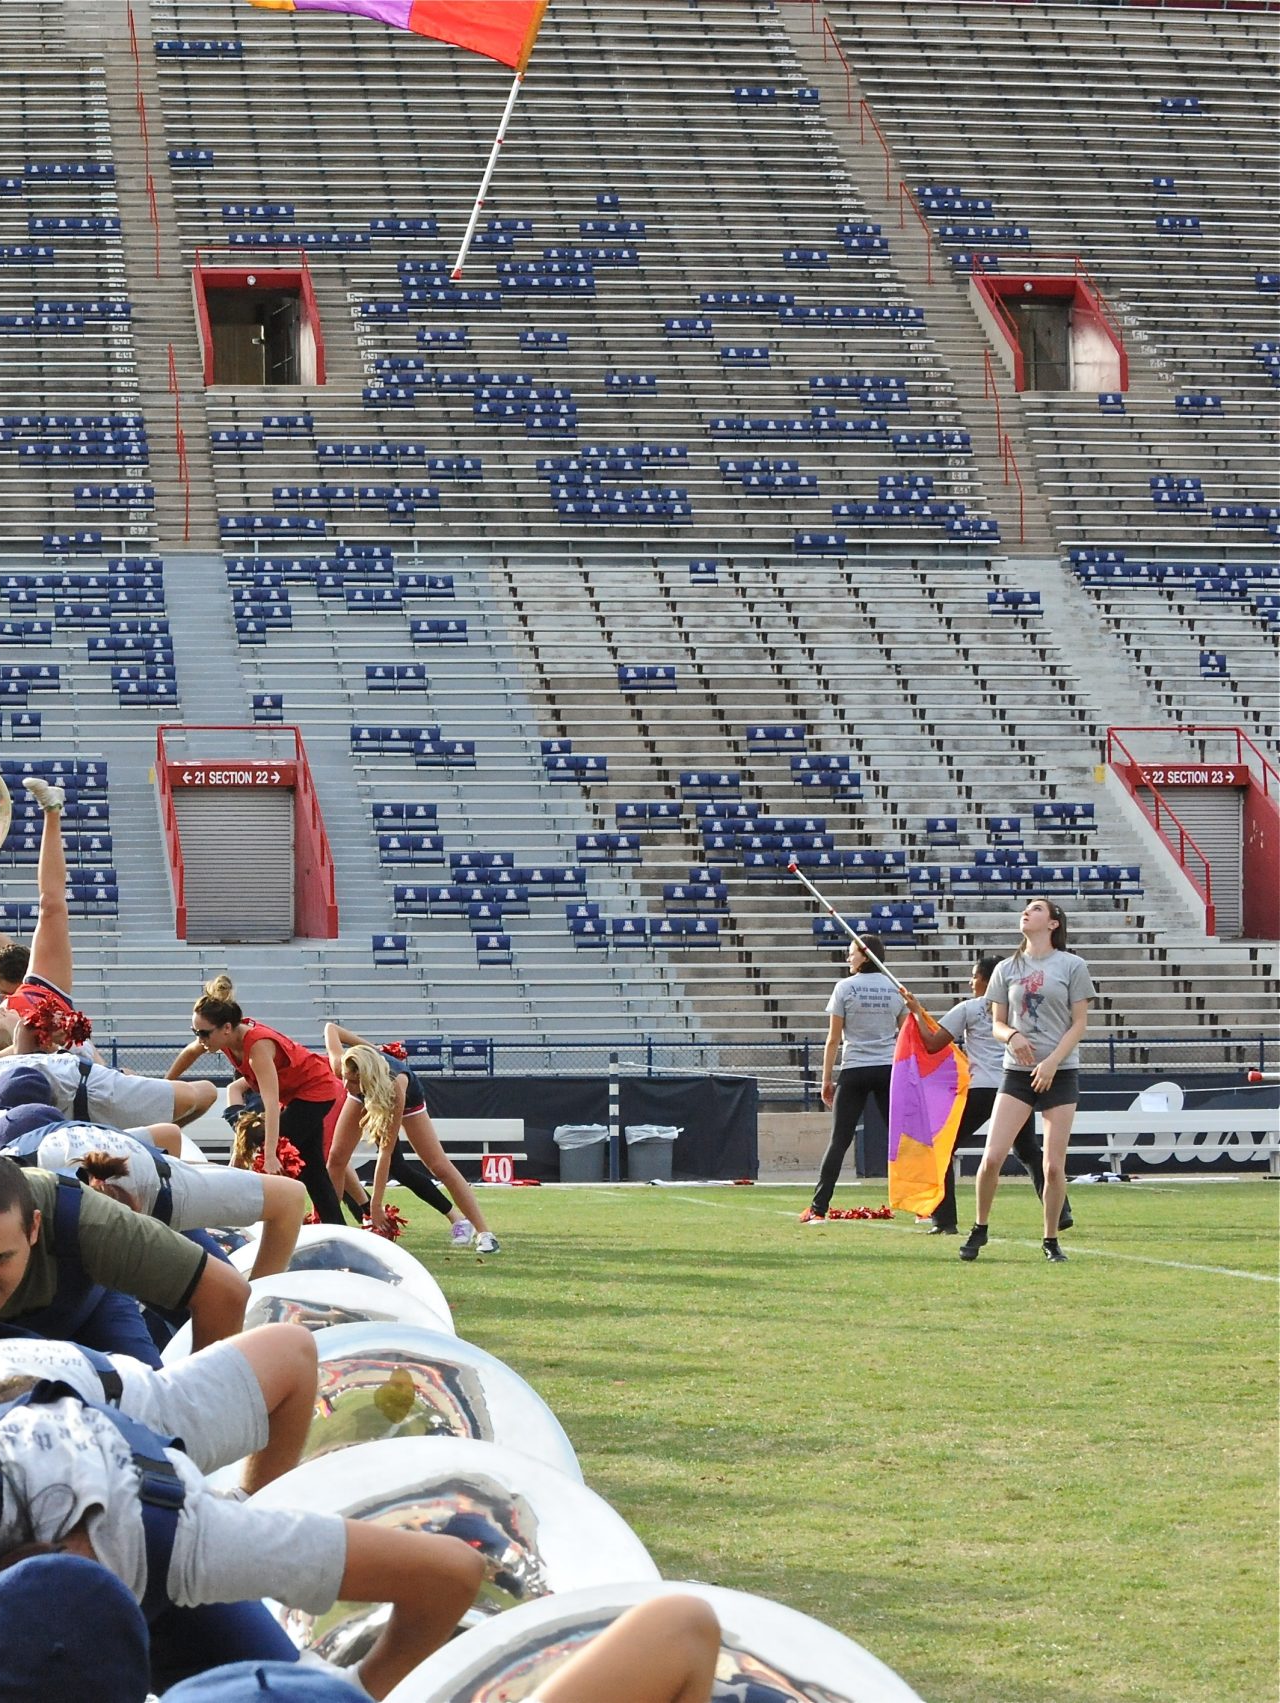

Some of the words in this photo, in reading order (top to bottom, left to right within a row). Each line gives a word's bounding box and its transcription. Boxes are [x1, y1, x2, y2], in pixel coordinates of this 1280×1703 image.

[194, 771, 205, 784] 21
[208, 771, 252, 784] SECTION
[256, 771, 268, 784] 22
[1152, 771, 1164, 784] 22
[1167, 771, 1208, 784] SECTION
[1211, 771, 1223, 784] 23
[484, 1157, 512, 1183] 40
